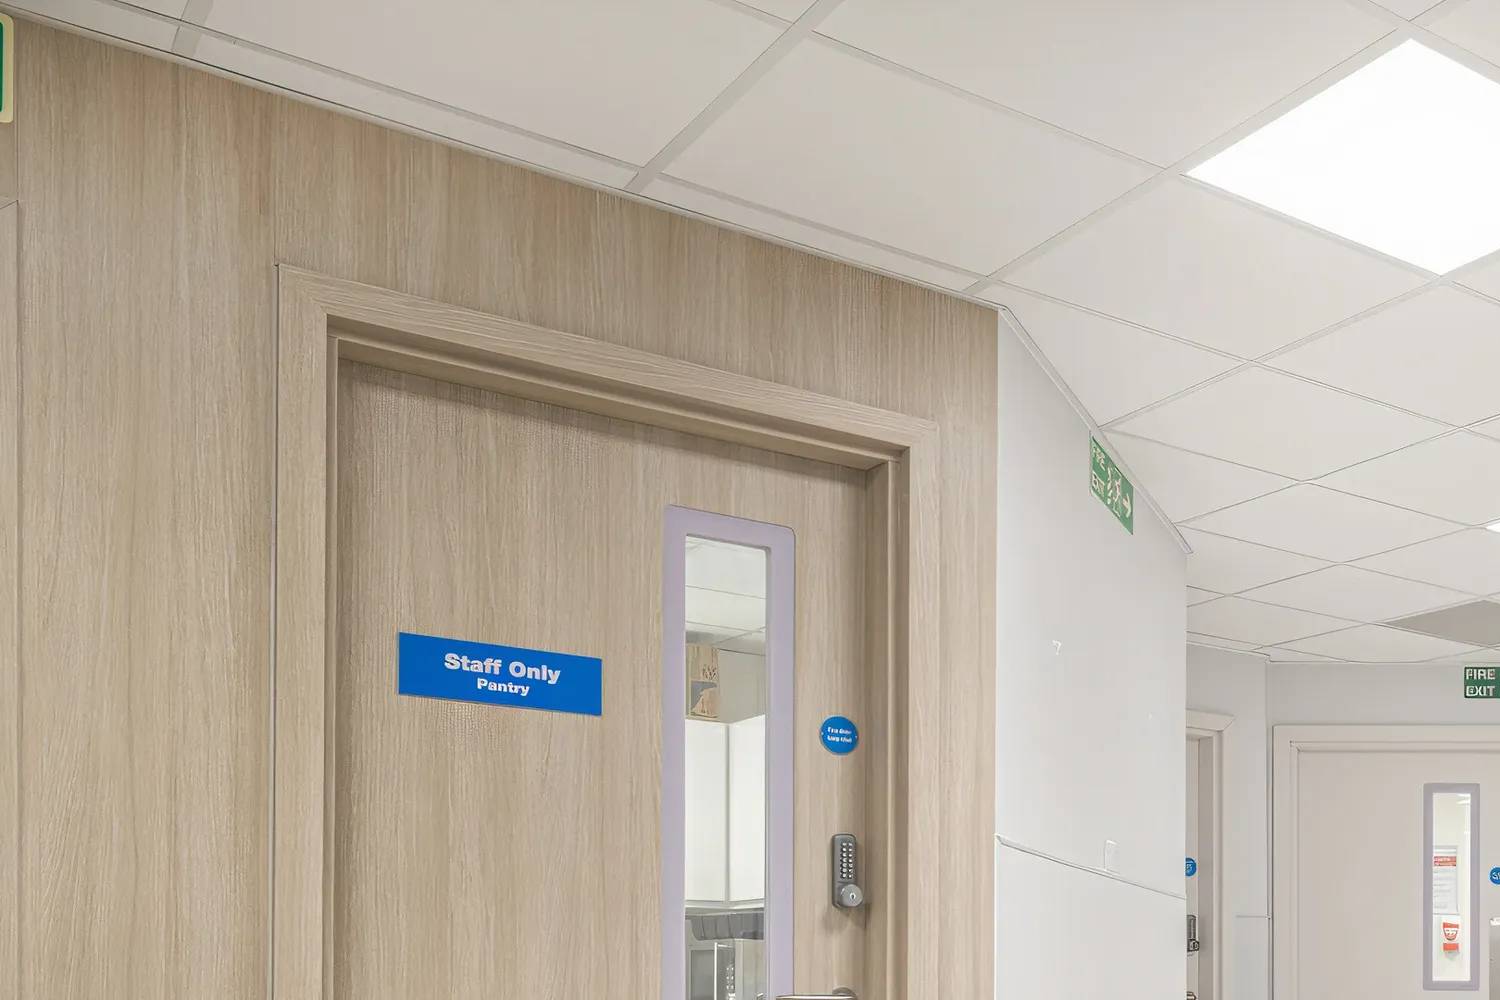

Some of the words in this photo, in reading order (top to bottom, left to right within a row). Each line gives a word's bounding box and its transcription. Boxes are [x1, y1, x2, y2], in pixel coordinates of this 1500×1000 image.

[444, 652, 503, 676] Staff
[508, 661, 561, 685] Only
[1465, 668, 1496, 680] FIRE
[476, 677, 531, 697] Pantry
[1465, 685, 1496, 697] EXIT
